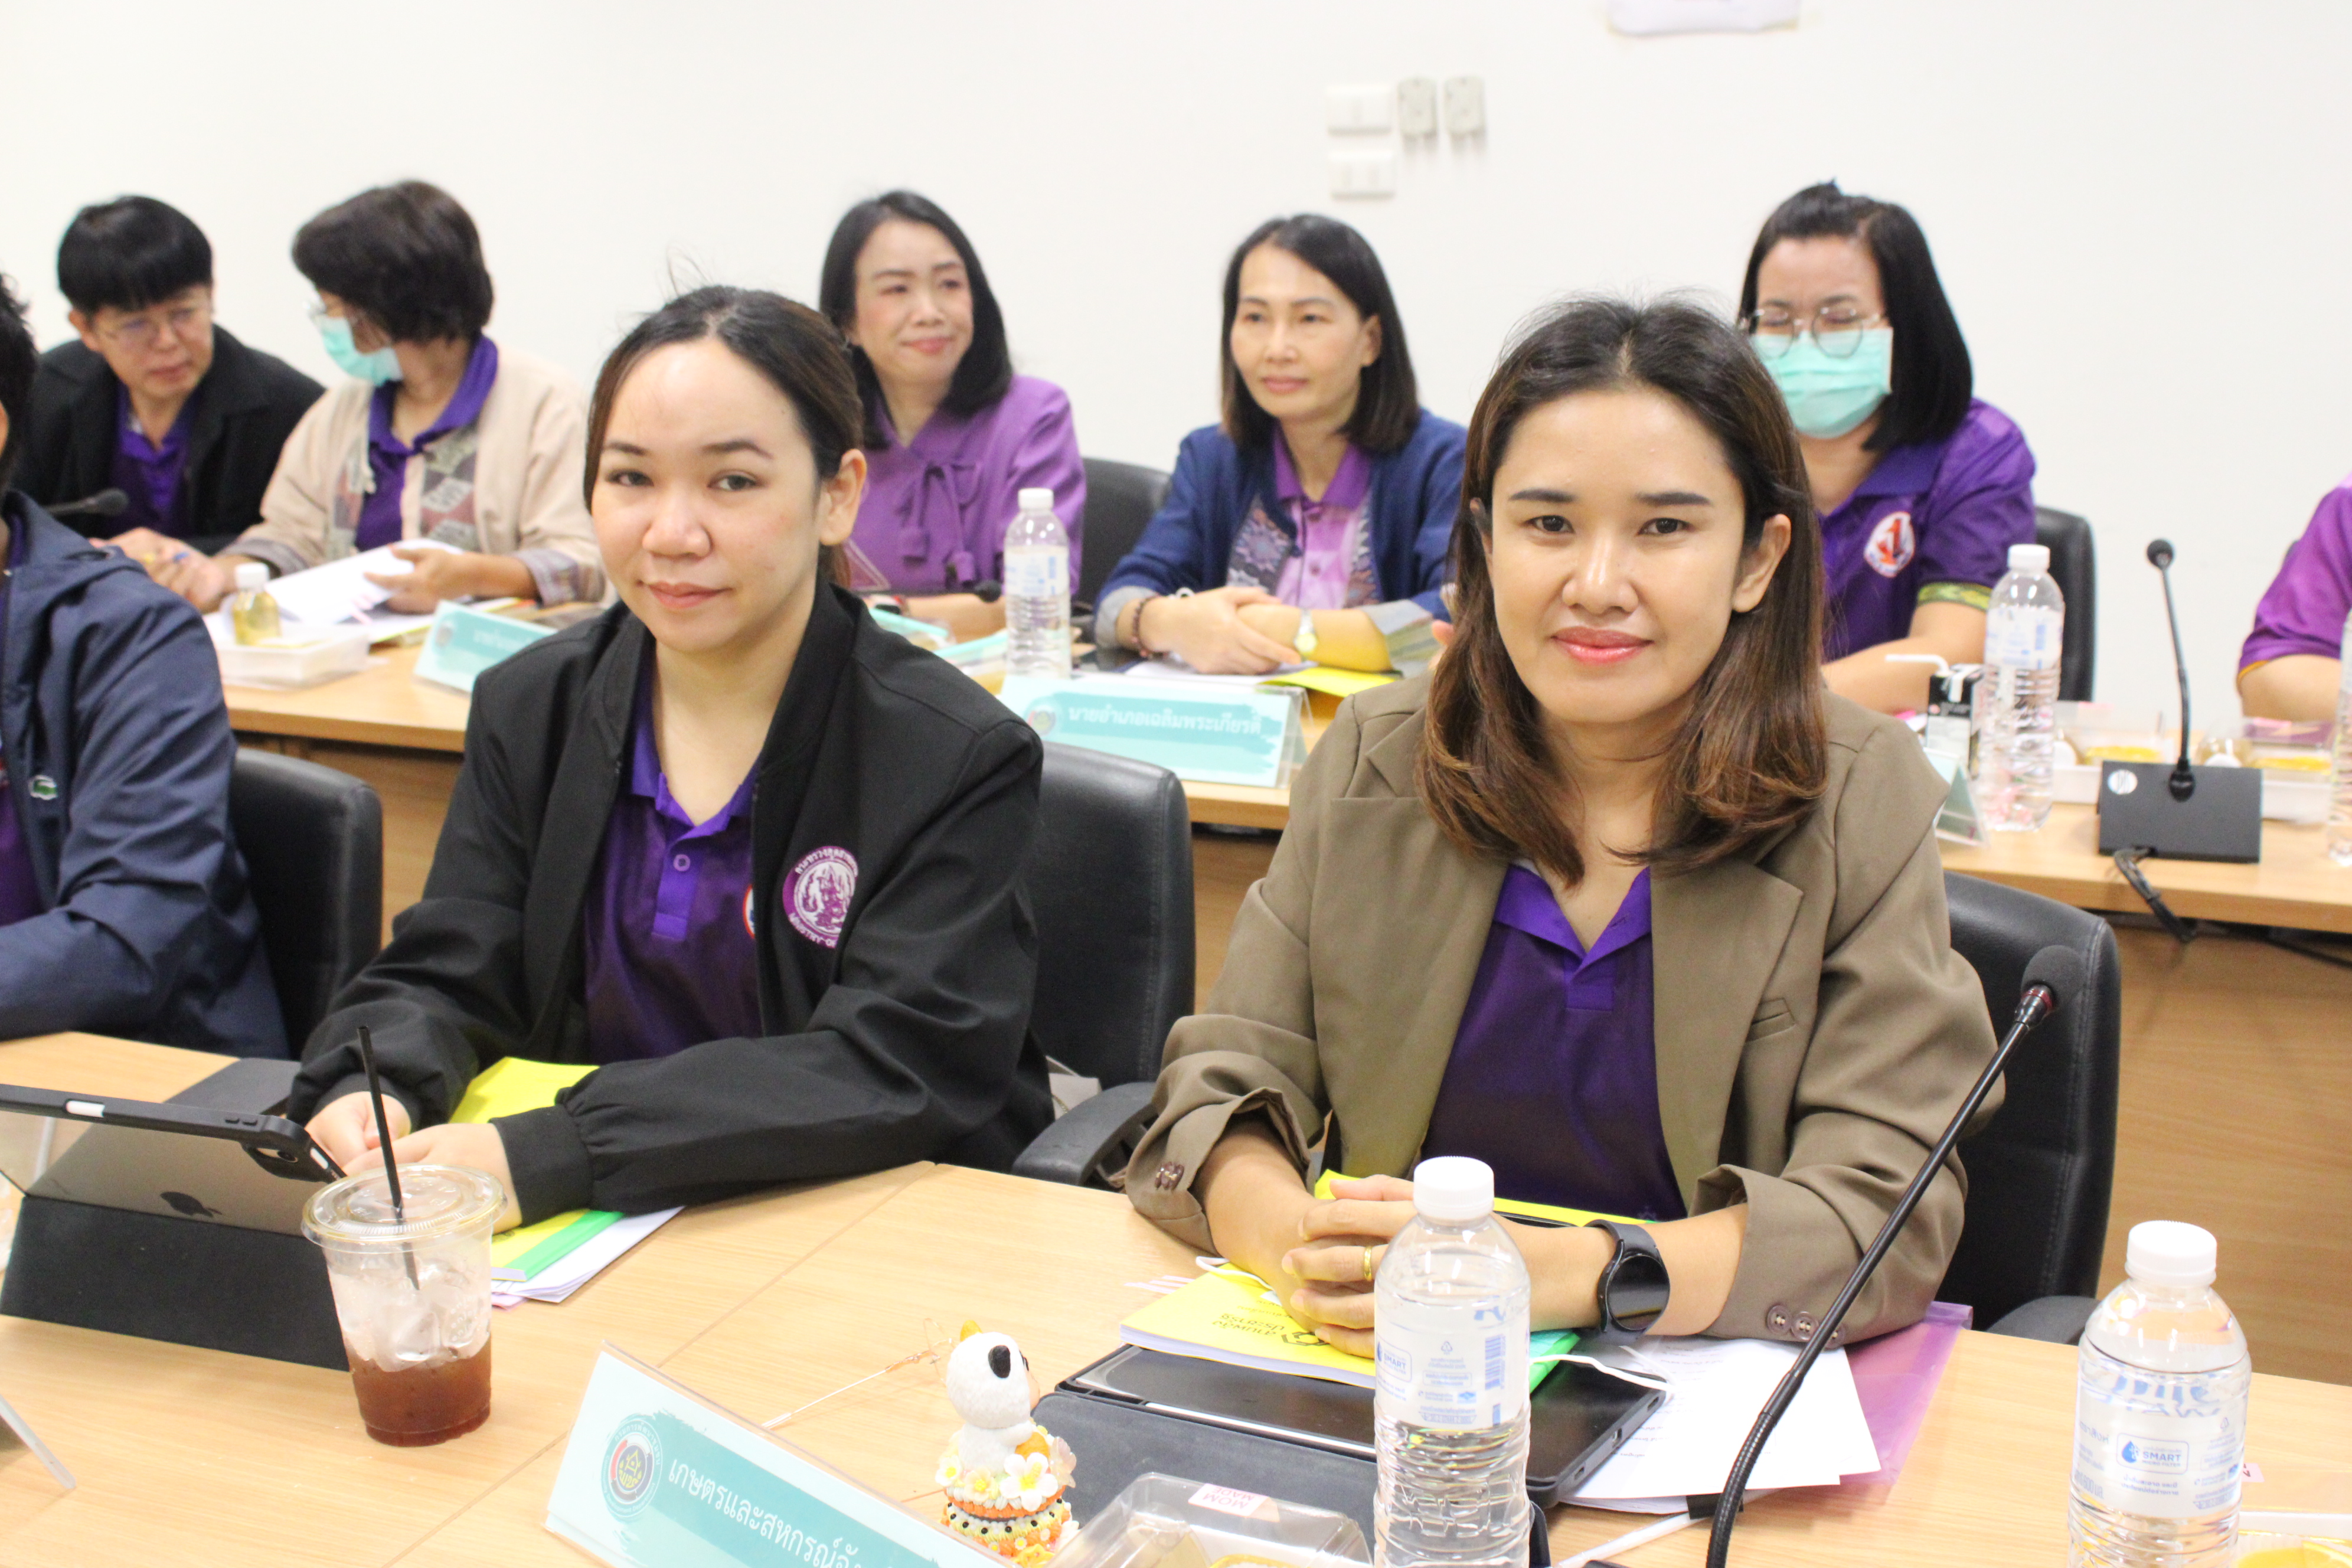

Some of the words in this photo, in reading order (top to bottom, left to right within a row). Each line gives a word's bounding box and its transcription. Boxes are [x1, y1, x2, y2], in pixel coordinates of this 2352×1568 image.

[1211, 1320, 1276, 1337] สานพลัง
[1220, 1314, 1285, 1331] ประชารัฐ
[1384, 1353, 1406, 1369] SMART
[2143, 1451, 2181, 1462] SMART
[1202, 1493, 1248, 1510] MOM
[1211, 1487, 1255, 1501] MADE
